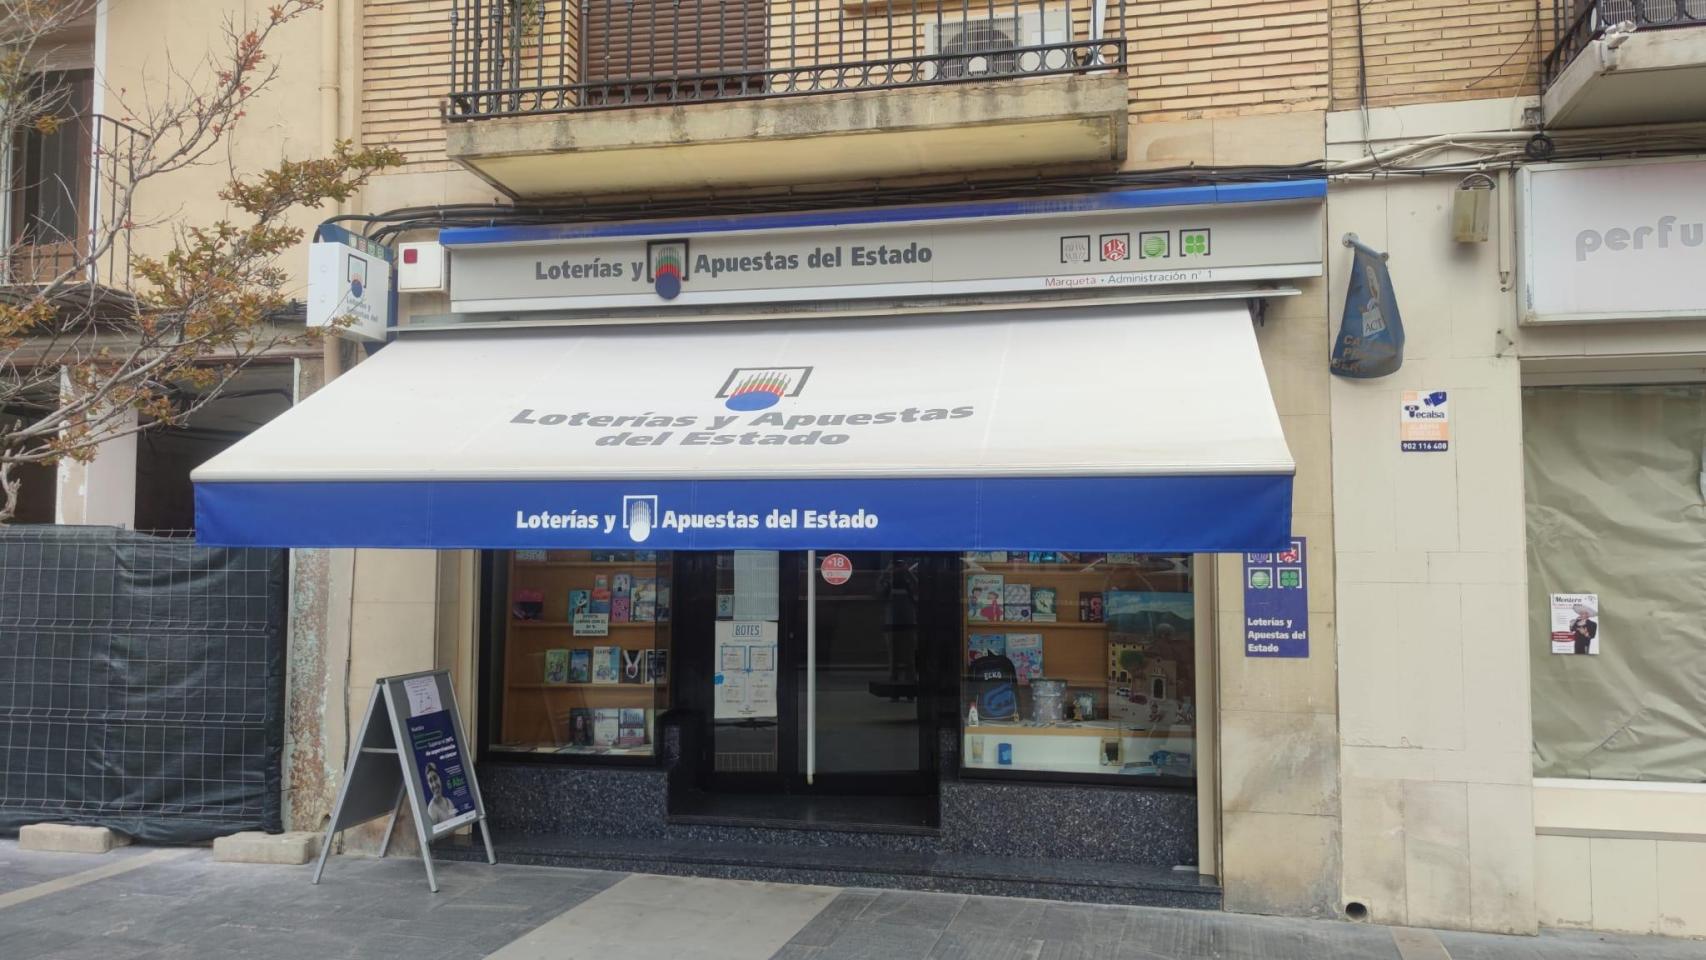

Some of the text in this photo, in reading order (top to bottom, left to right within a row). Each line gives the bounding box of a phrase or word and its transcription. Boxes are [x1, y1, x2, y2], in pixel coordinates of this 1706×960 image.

[1575, 215, 1704, 262] perfu
[535, 242, 933, 281] Loterías y Apuestas del Estado
[1045, 276, 1097, 288] Marqueta
[1108, 271, 1187, 285] Administración
[1207, 269, 1213, 279] 1
[510, 405, 976, 431] Loterías y Apuestas
[594, 430, 851, 447] del Estado
[516, 508, 878, 534] Loterías y Apuestas del Estado
[735, 624, 760, 636] BOTES
[1247, 617, 1293, 628] Loterías y
[1247, 630, 1306, 641] Apuestas del
[1247, 643, 1279, 652] Estado
